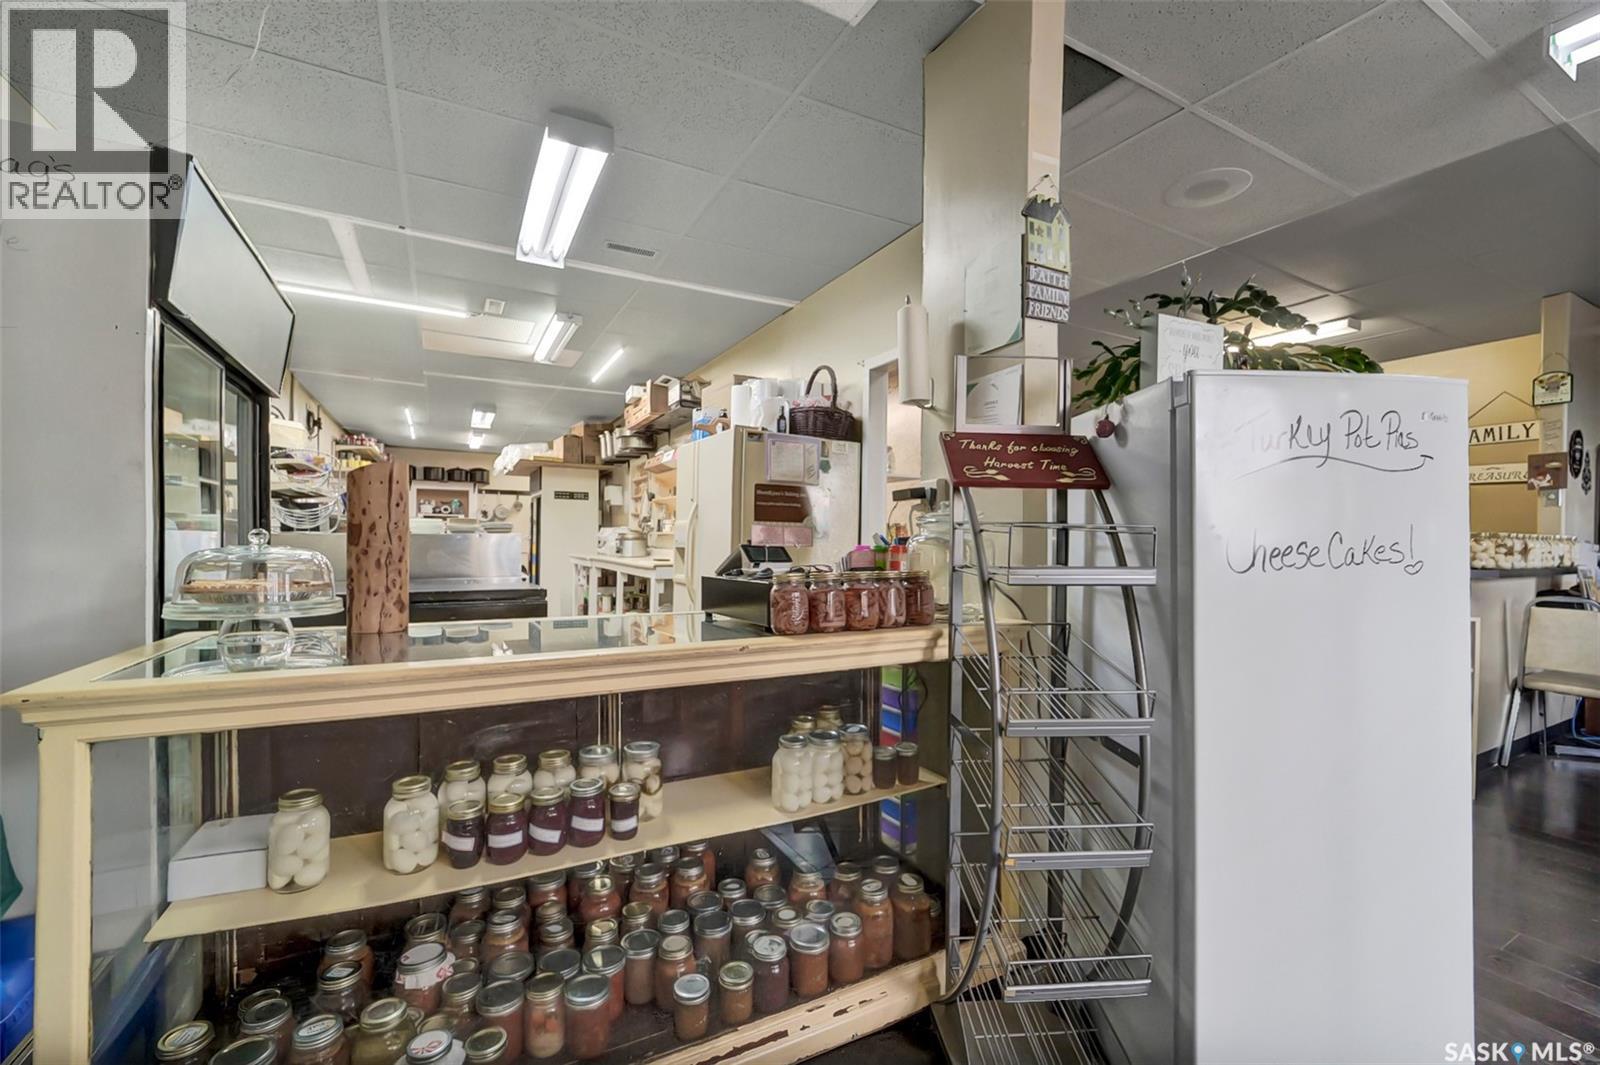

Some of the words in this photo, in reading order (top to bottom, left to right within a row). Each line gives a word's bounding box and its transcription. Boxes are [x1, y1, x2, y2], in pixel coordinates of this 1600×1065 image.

[0, 153, 76, 191] ag's
[1030, 265, 1070, 288] FAITH
[1029, 282, 1070, 306] FAMILY
[1029, 301, 1070, 321] FRIENDS
[1340, 409, 1381, 450] Pot
[1468, 422, 1536, 444] AMILY
[959, 438, 1003, 451] Thanks
[1008, 441, 1028, 453] for
[1031, 444, 1079, 457] choosing
[984, 456, 1034, 469] Harvest
[1041, 459, 1068, 471] Time
[1469, 470, 1528, 482] REASUR
